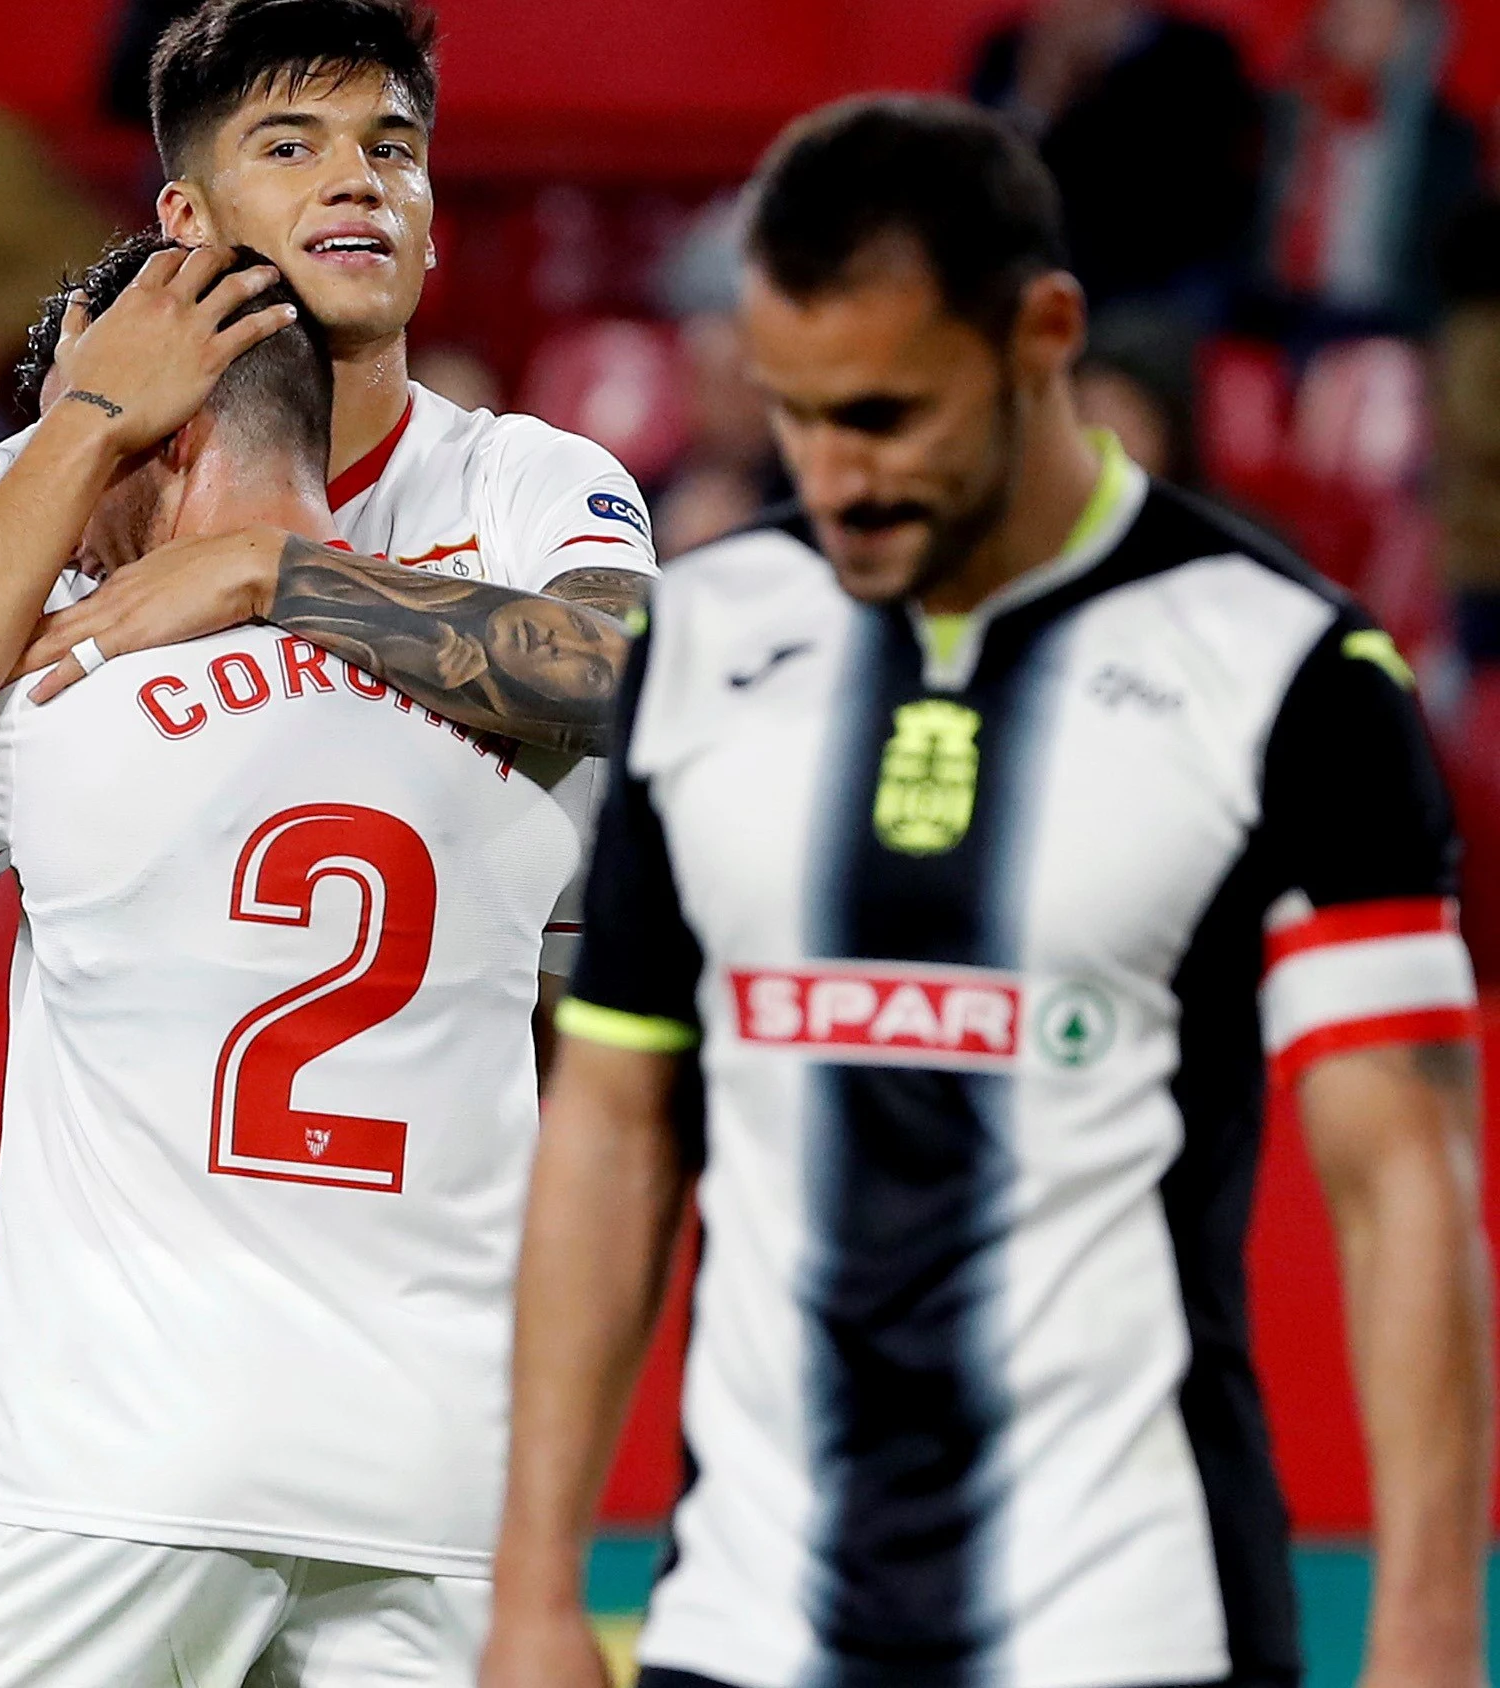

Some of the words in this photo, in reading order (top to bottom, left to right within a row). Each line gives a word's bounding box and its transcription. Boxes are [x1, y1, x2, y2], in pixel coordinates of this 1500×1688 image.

[136, 635, 522, 782] CORC
[207, 802, 438, 1195] 2
[747, 976, 1014, 1051] SPAR
